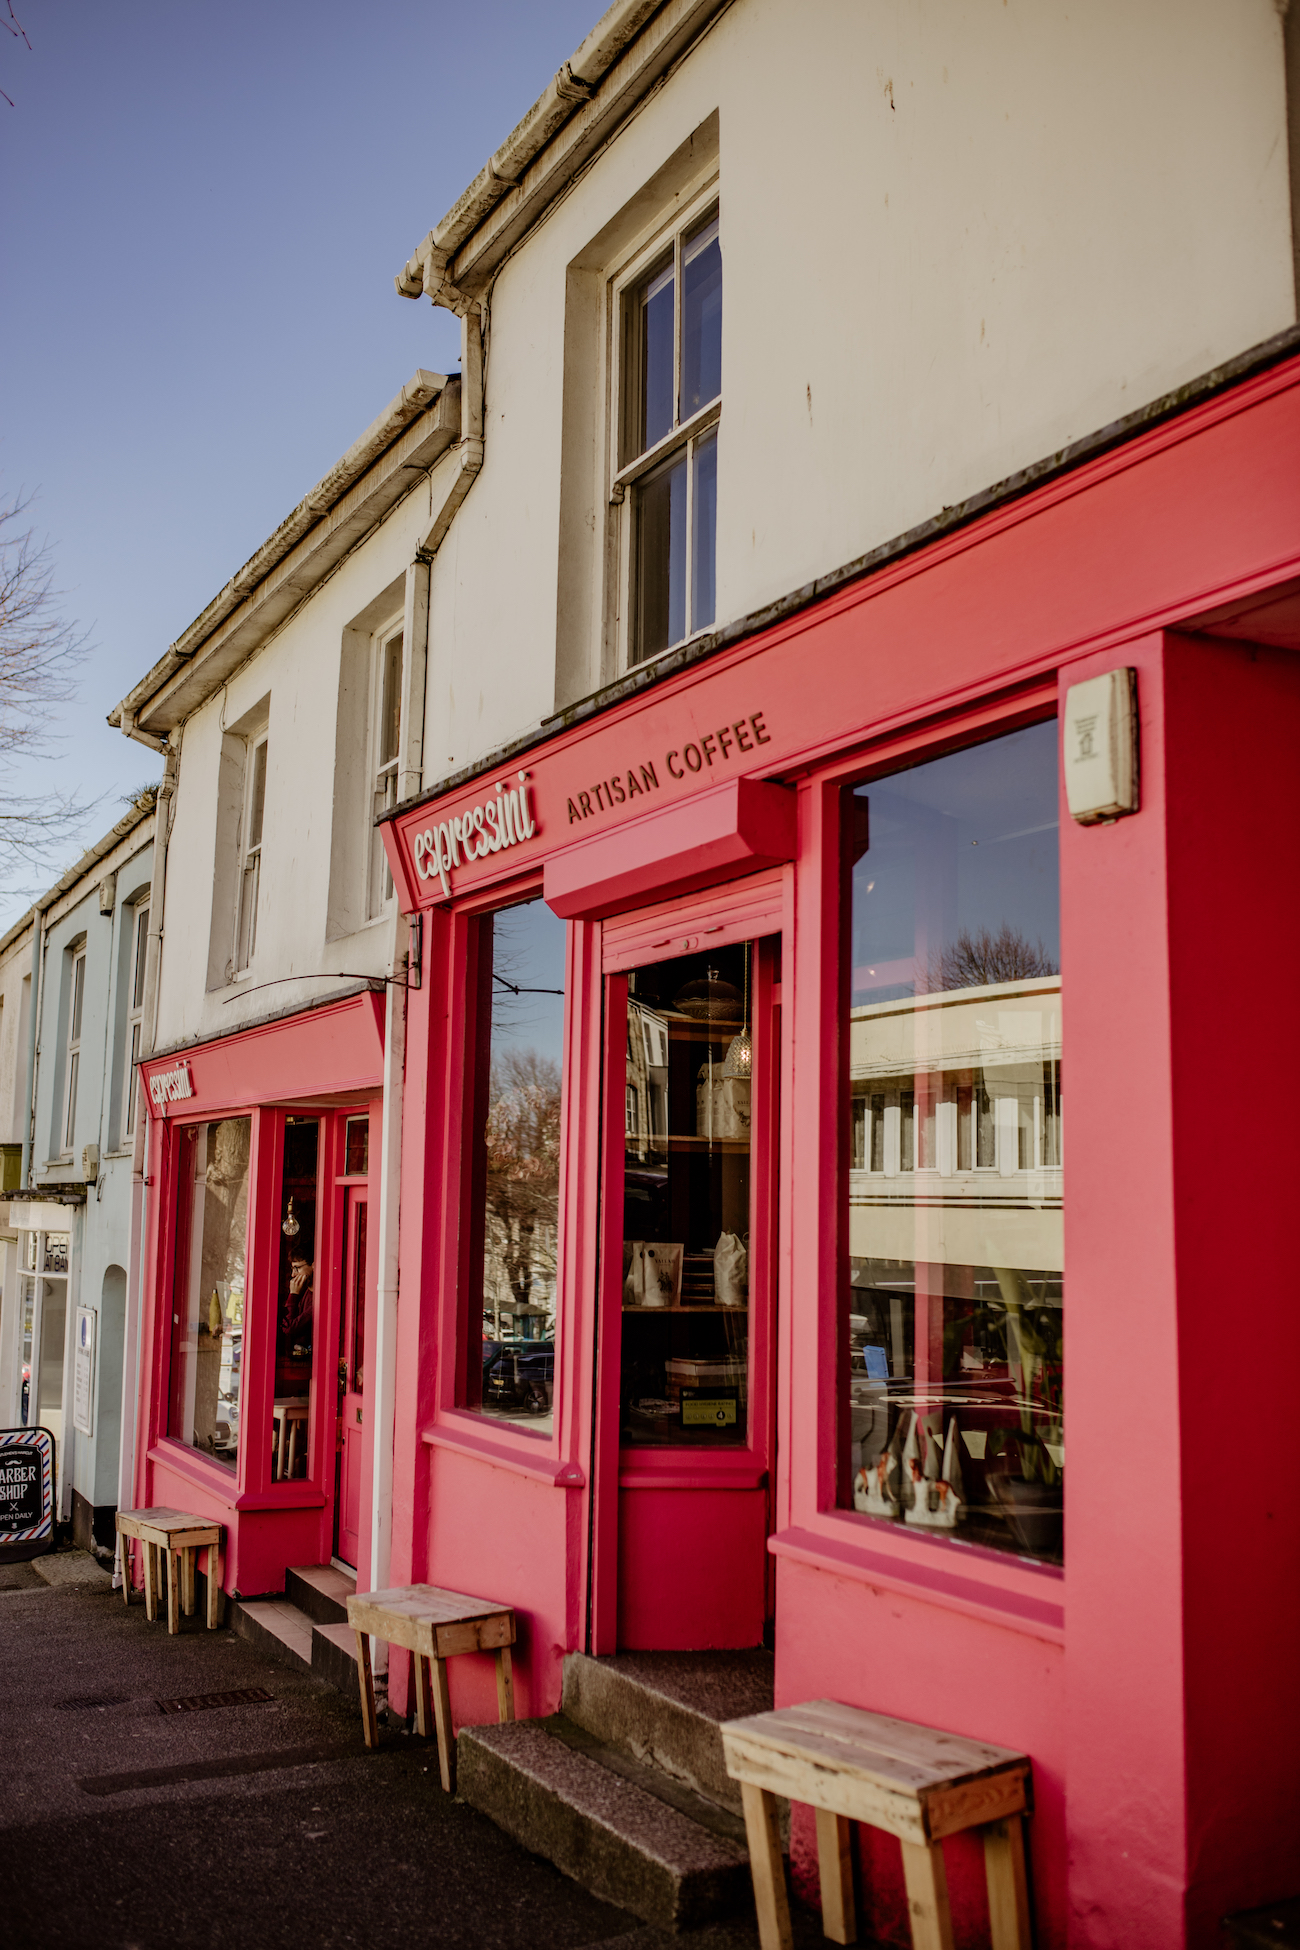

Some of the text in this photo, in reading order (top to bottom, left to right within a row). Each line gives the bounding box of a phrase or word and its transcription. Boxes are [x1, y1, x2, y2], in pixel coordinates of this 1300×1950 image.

[566, 711, 771, 824] ARTISAN COFFEE
[413, 769, 536, 897] espressini
[149, 1059, 192, 1118] espressini
[718, 1411, 723, 1419] 4
[0, 1484, 28, 1500] SHOP
